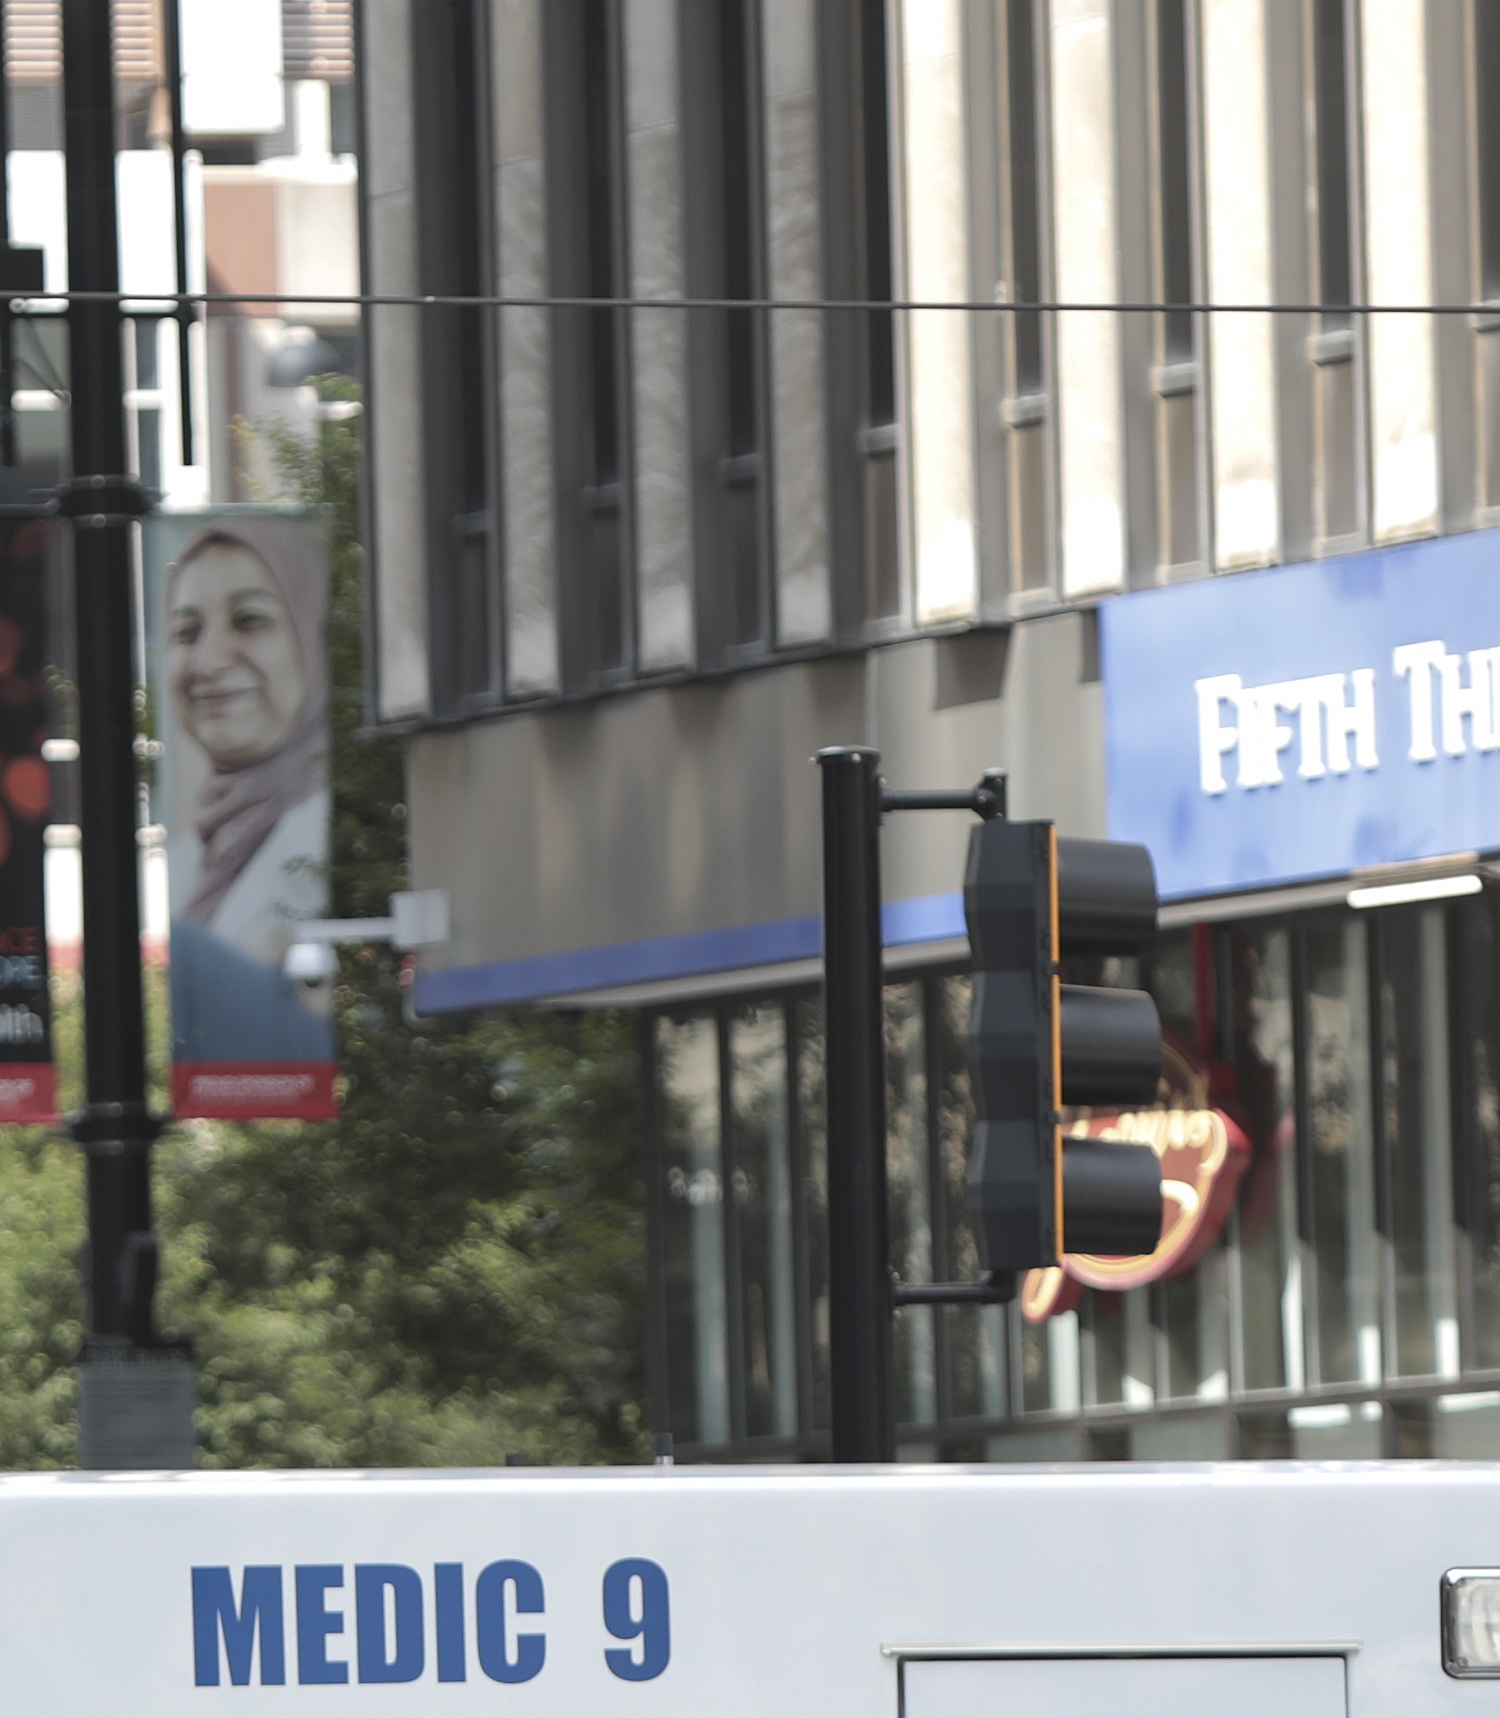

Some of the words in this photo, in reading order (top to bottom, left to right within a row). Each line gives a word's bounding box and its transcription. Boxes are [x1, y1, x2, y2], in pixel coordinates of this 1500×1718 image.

[1194, 668, 1379, 796] FIFTH
[190, 1559, 547, 1688] MEDIC
[602, 1557, 672, 1683] 9
